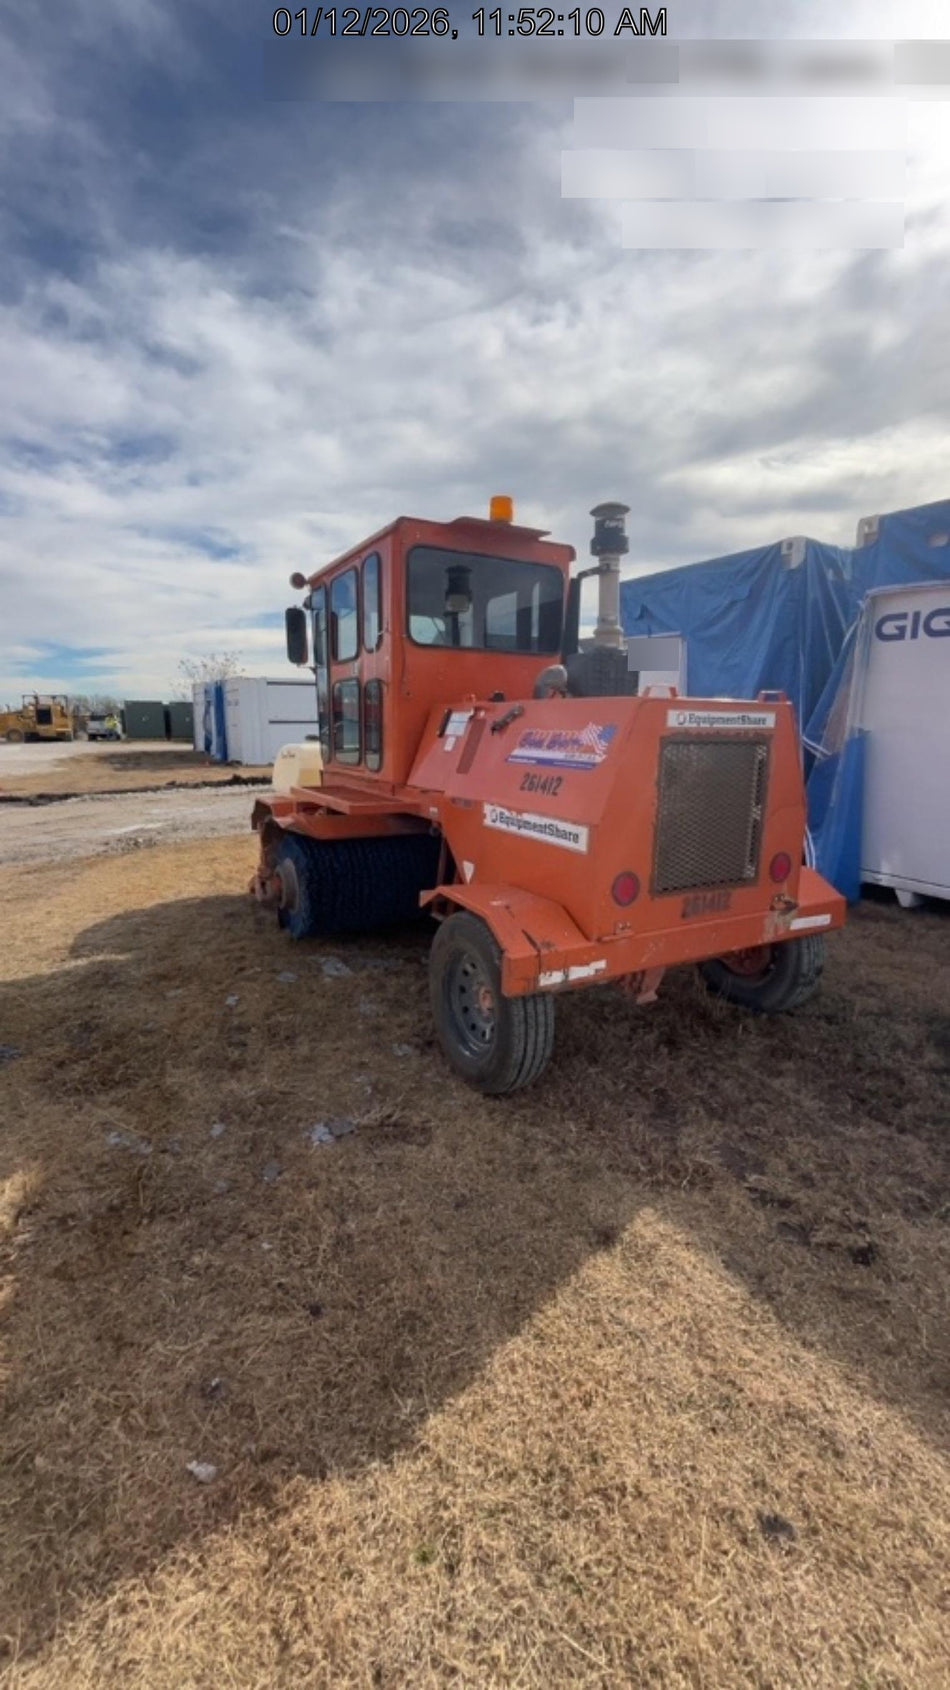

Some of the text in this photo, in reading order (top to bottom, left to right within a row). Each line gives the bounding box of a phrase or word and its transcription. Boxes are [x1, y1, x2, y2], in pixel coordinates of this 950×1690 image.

[688, 713, 767, 727] EquipmentShare
[520, 772, 563, 797] 261412
[499, 810, 580, 844] EquipmentShare
